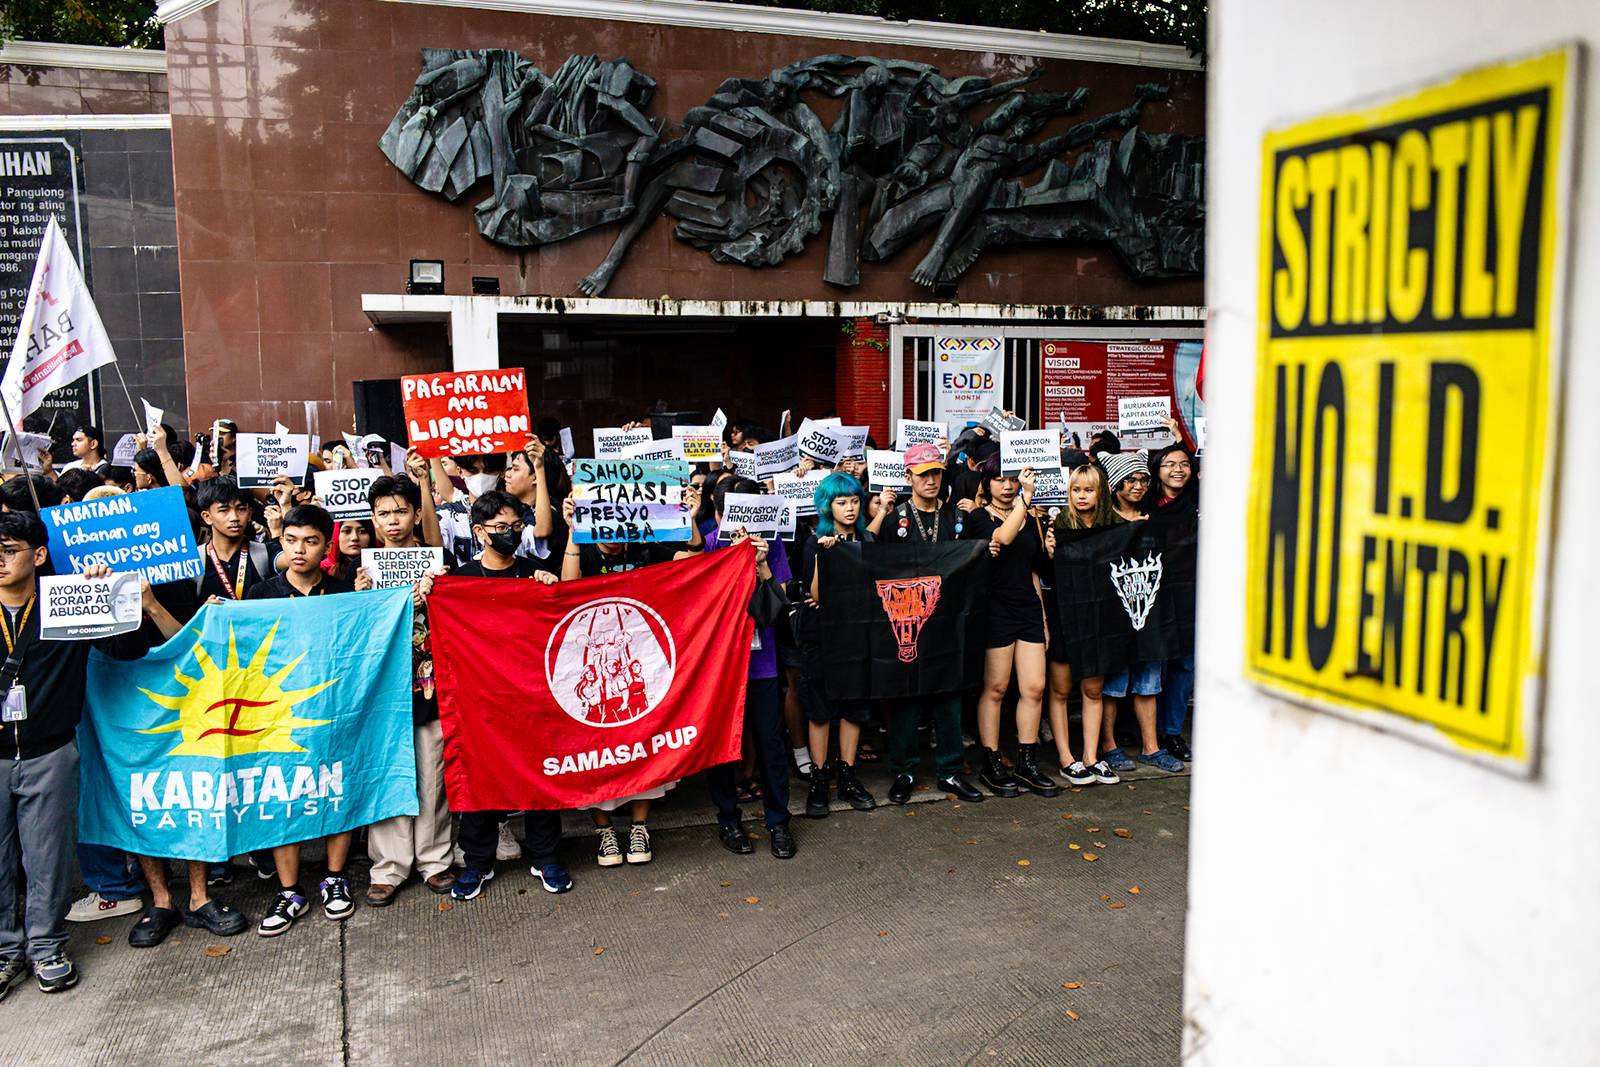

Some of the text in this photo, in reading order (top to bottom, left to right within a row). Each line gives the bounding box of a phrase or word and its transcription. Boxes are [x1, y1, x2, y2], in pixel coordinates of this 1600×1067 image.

[7, 187, 65, 199] Pangulong
[20, 203, 35, 212] ng
[39, 201, 65, 211] ating
[1274, 104, 1540, 331] STRICTLY
[1047, 359, 1078, 367] VISION
[403, 372, 523, 400] PAG-ARALAN
[943, 373, 994, 389] EODB
[448, 395, 488, 412] ANG
[1124, 402, 1165, 410] BURUKRATA
[410, 415, 528, 442] LIPUNAN
[905, 424, 931, 432] SERBISYO
[257, 437, 281, 446] Dapat
[801, 437, 839, 459] KORAP!
[1010, 438, 1050, 446] KORAPSYON
[1374, 361, 1501, 531] I.D.
[257, 445, 297, 456] Panagutin
[634, 449, 673, 461] DUTERTE
[257, 459, 288, 469] Walang
[874, 462, 905, 470] PANAGU
[1002, 456, 1031, 464] MARCOS
[257, 467, 279, 477] Hiya!
[579, 462, 644, 483] SAHOD
[890, 470, 906, 478] KOR
[332, 478, 370, 491] STOP
[325, 492, 369, 506] KORA
[588, 481, 666, 505] ITAAS!
[50, 496, 138, 527] KABATAAN,
[575, 505, 649, 524] PRESYO
[729, 505, 779, 515] EDUKASYON
[1263, 359, 1346, 672] NO
[727, 514, 777, 523] HINDI GERA!
[62, 522, 160, 547] labanan ang
[591, 522, 655, 541] IBABA
[69, 534, 188, 574] KORUPSYON!
[373, 550, 435, 560] BUDGET SA
[146, 558, 201, 584] PARTYLIST
[378, 560, 431, 570] SERBISYO
[381, 570, 411, 579] HINDI
[49, 583, 110, 596] AYOKO SA
[50, 594, 109, 606] KORAP AT
[49, 605, 111, 617] ABUSADO
[1358, 534, 1509, 716] ENTRY
[542, 724, 698, 777] SAMASA PUP
[129, 760, 343, 811] KABATAAN
[131, 796, 344, 830] PARTYLIST
